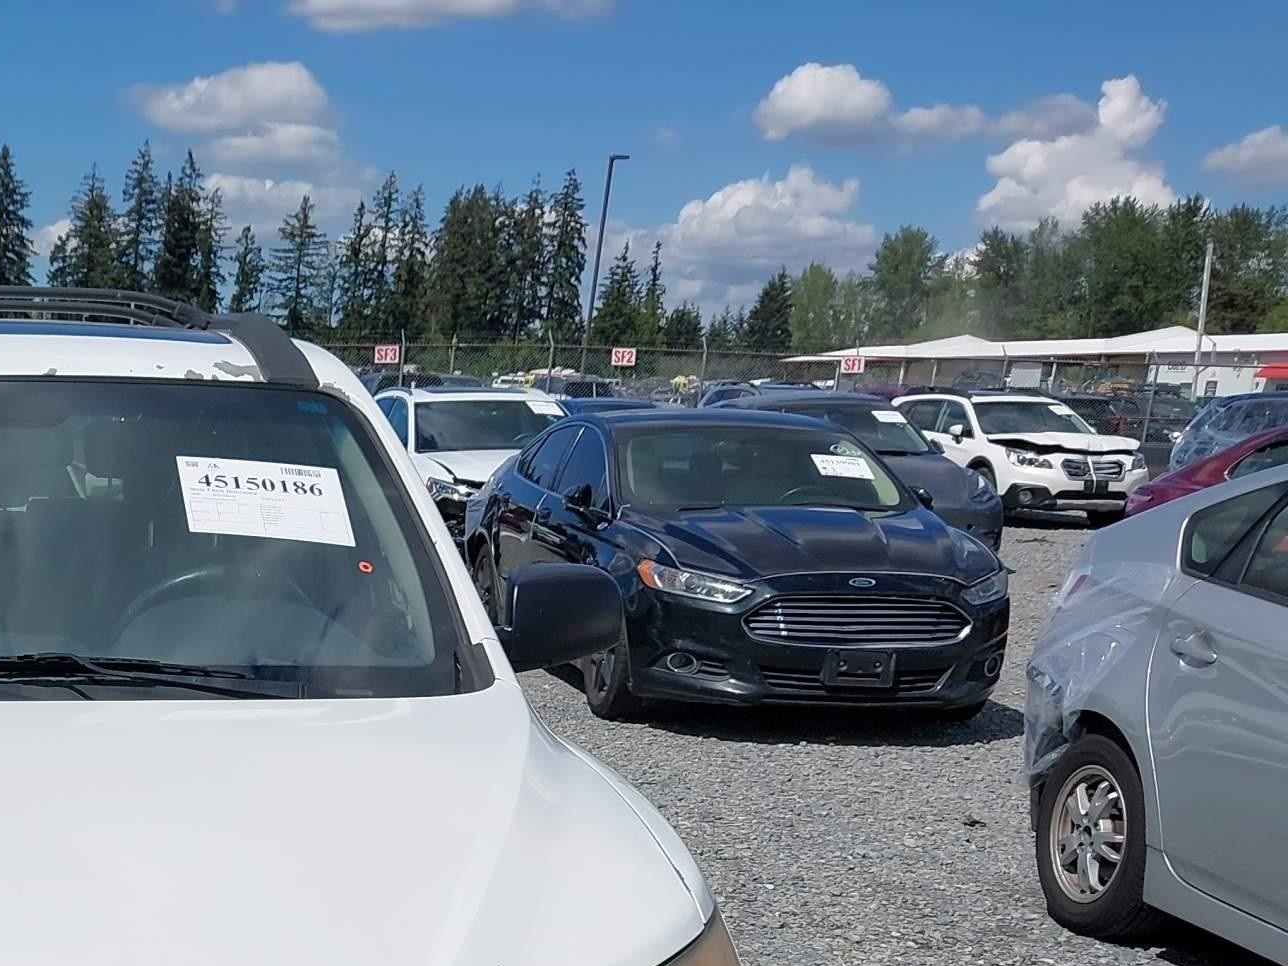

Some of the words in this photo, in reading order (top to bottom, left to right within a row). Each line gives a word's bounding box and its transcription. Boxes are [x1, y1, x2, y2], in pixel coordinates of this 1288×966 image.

[377, 347, 398, 361] SF3
[614, 350, 634, 364] SF2
[844, 358, 862, 371] SF1
[198, 474, 324, 497] 45150186
